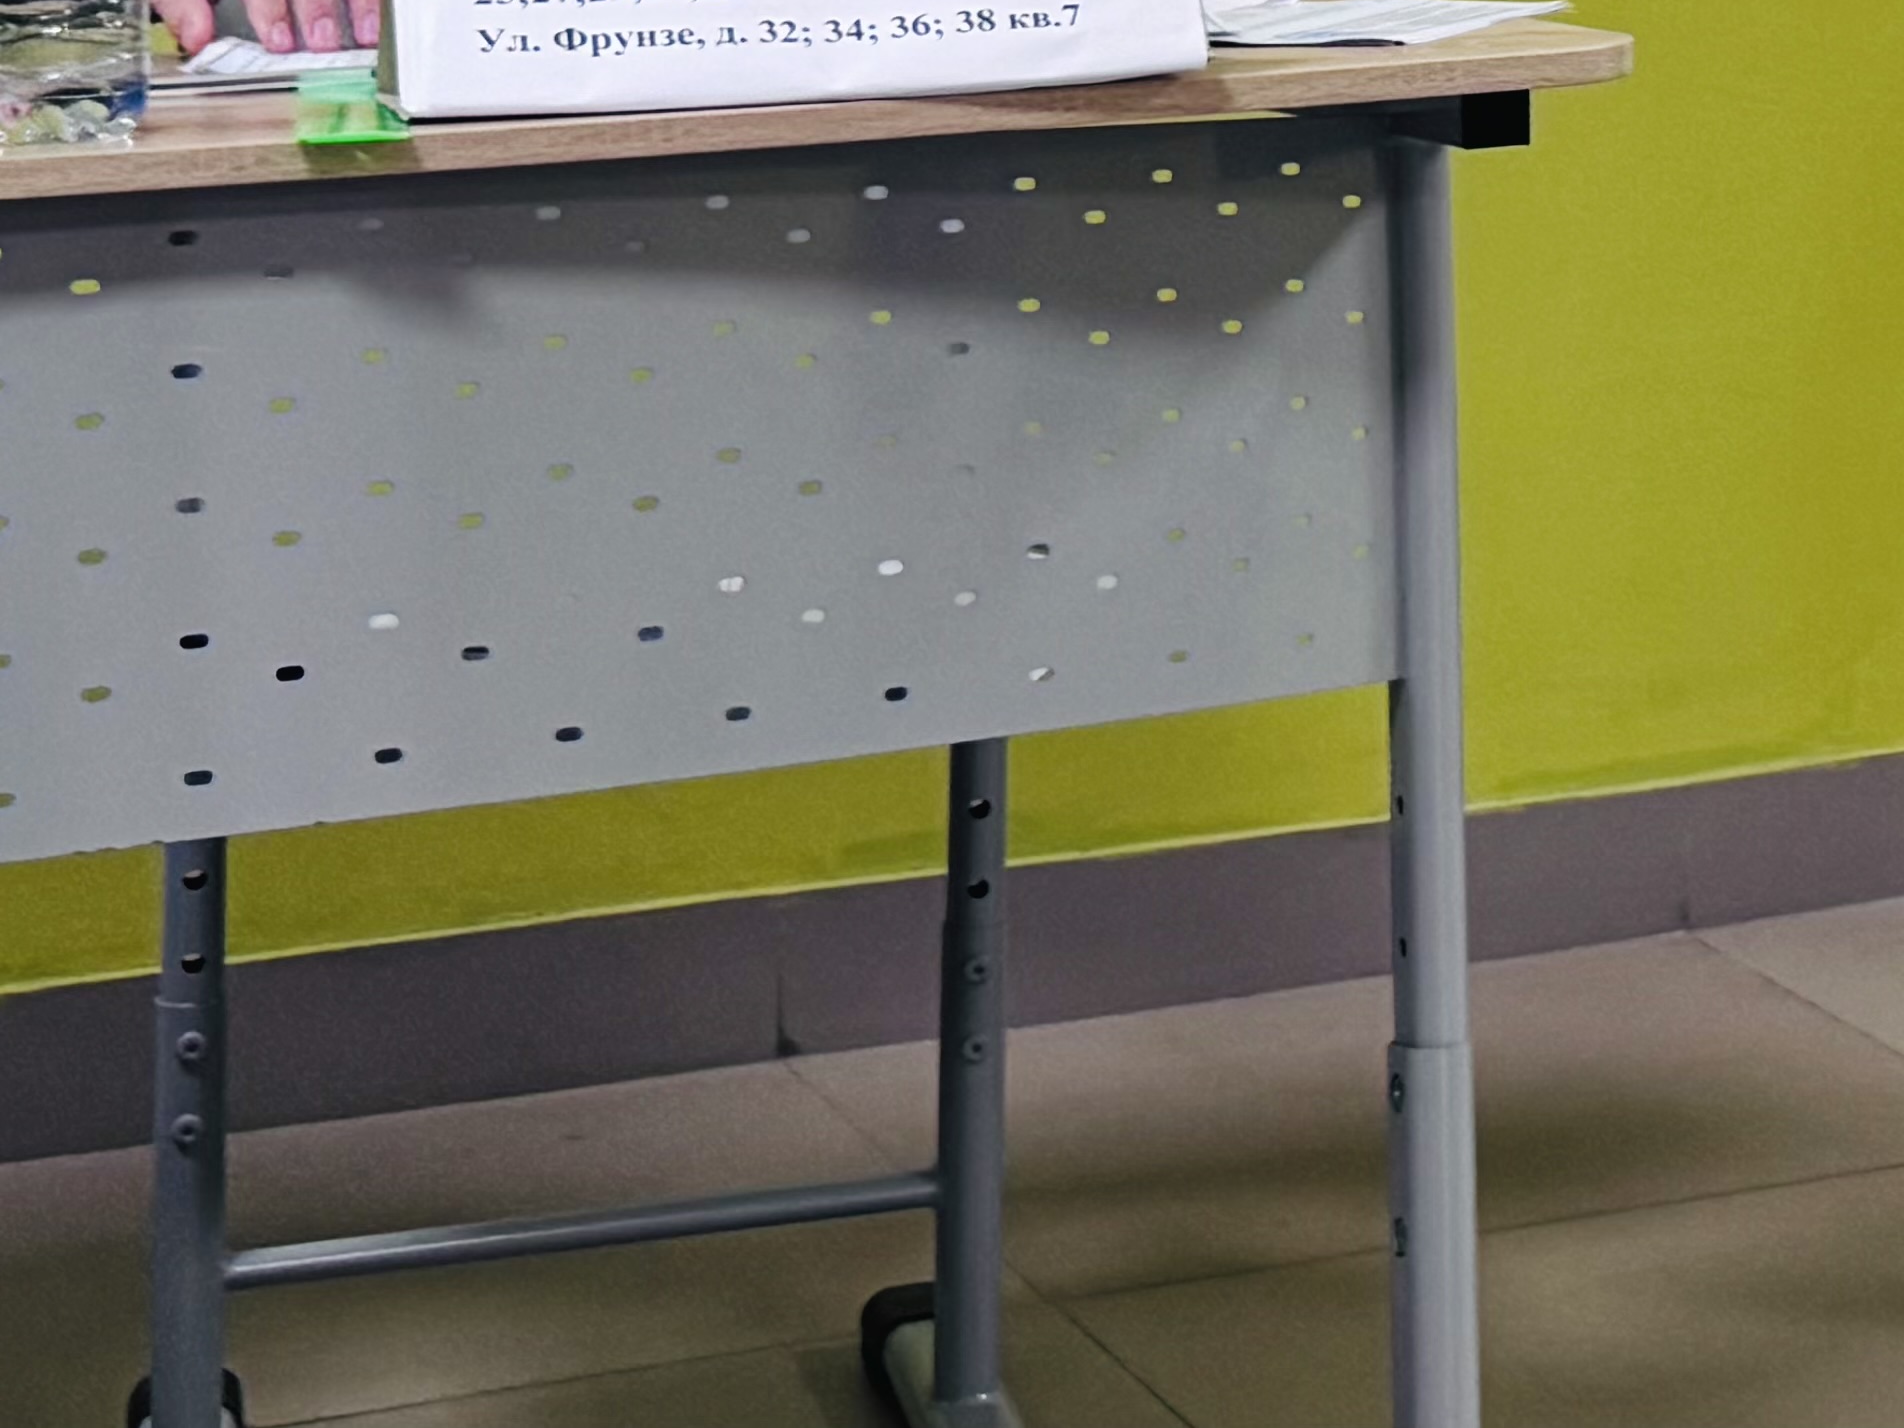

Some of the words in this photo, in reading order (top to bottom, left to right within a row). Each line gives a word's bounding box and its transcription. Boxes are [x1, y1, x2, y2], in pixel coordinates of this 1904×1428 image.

[477, 29, 541, 53] Ул.
[553, 26, 706, 57] Фрунзе,
[715, 25, 748, 46] д.
[758, 19, 813, 48] 32;
[824, 19, 879, 45] 34;
[891, 13, 944, 41] 36;
[956, 8, 996, 33] 38
[1009, 4, 1080, 31] кв.7
